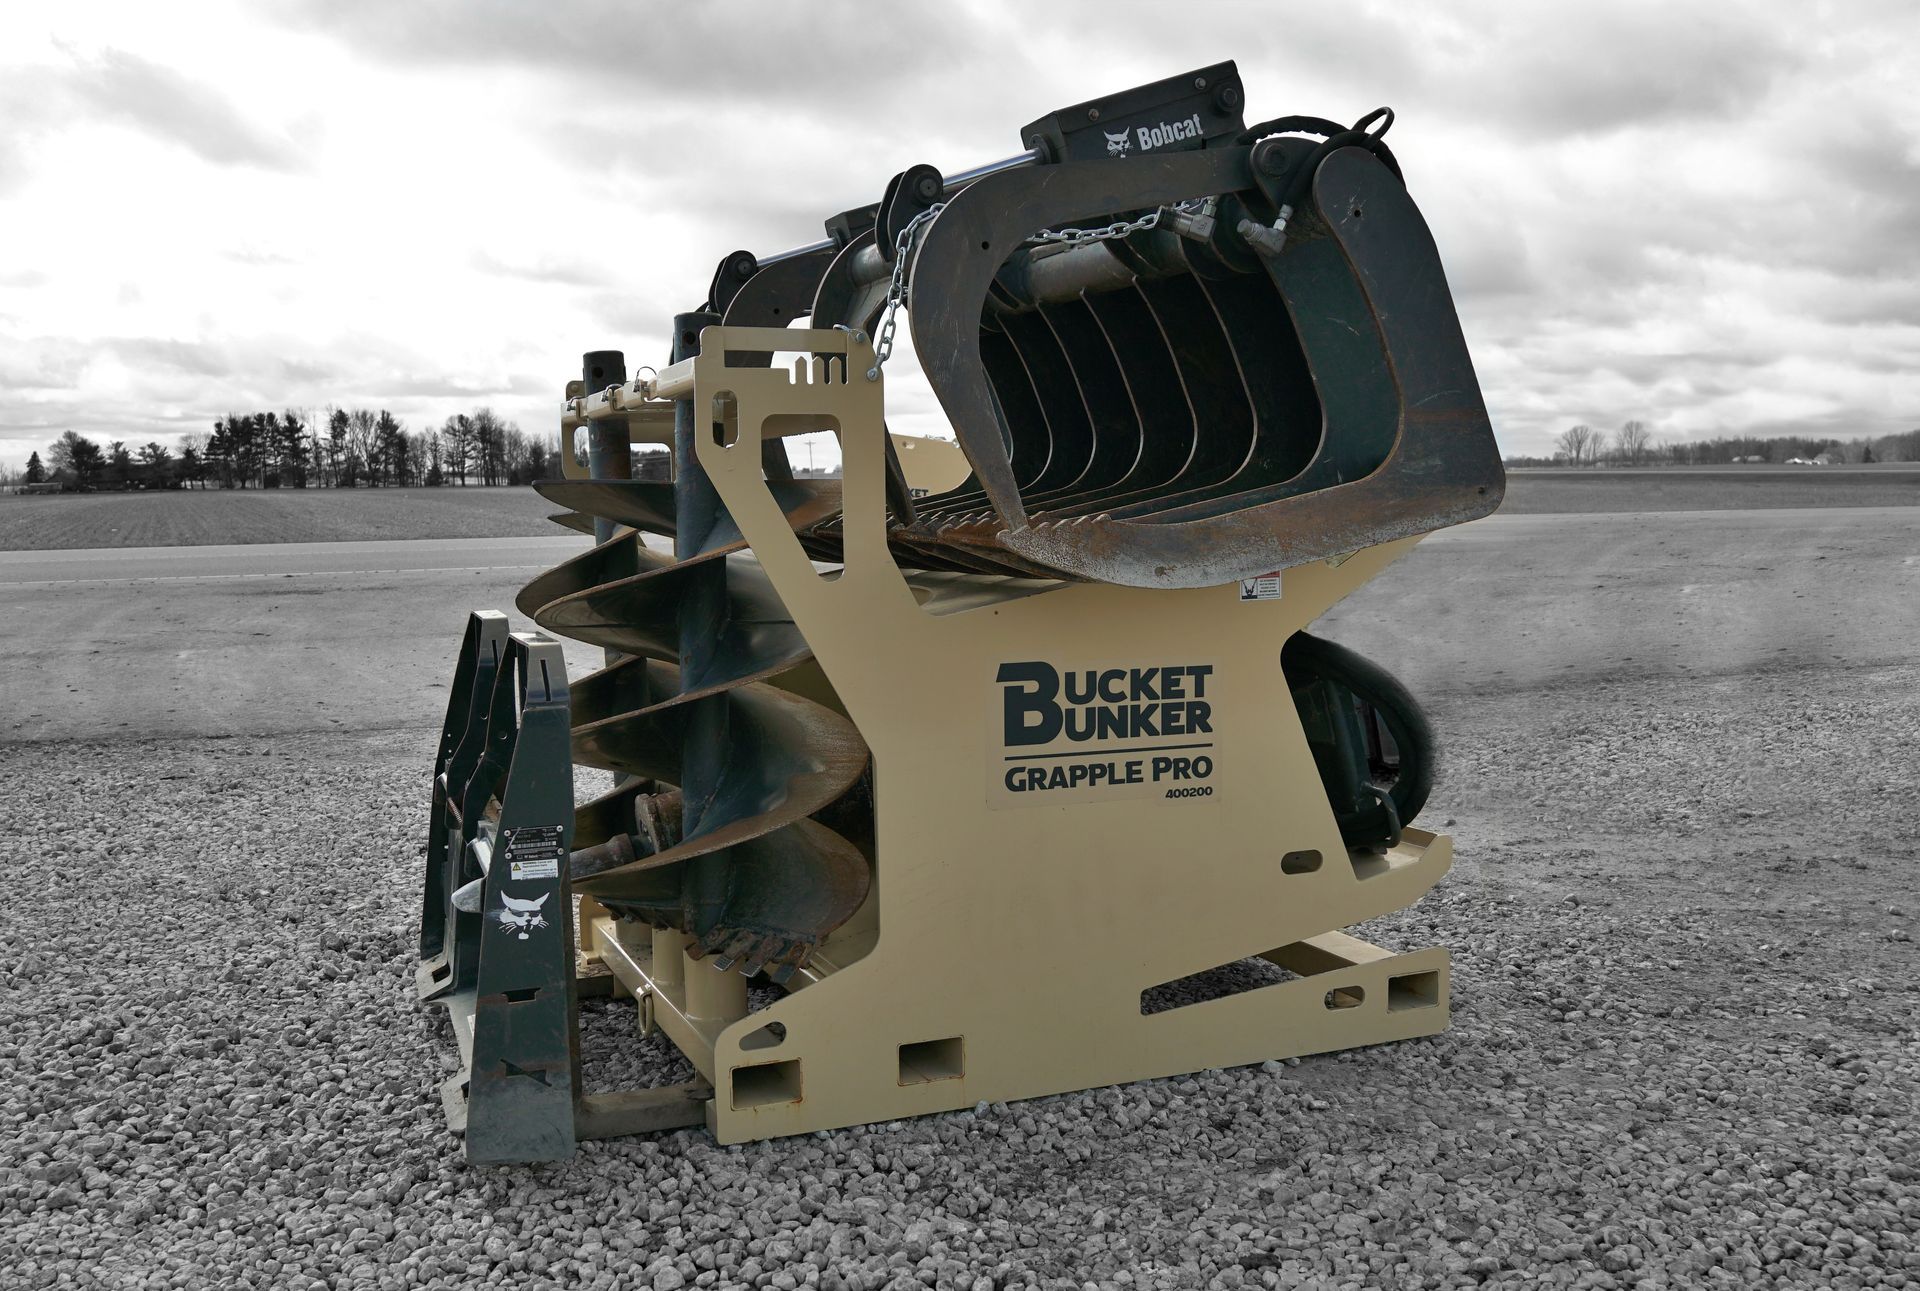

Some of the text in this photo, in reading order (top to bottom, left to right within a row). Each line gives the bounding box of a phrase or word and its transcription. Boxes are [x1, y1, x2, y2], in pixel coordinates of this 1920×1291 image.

[1136, 113, 1203, 151] Bobcat
[909, 488, 929, 498] KET
[996, 661, 1213, 706] BUCKET
[1004, 700, 1213, 746] BUNKER
[1005, 756, 1213, 792] GRAPPLE PRO
[1165, 786, 1213, 799] 400200
